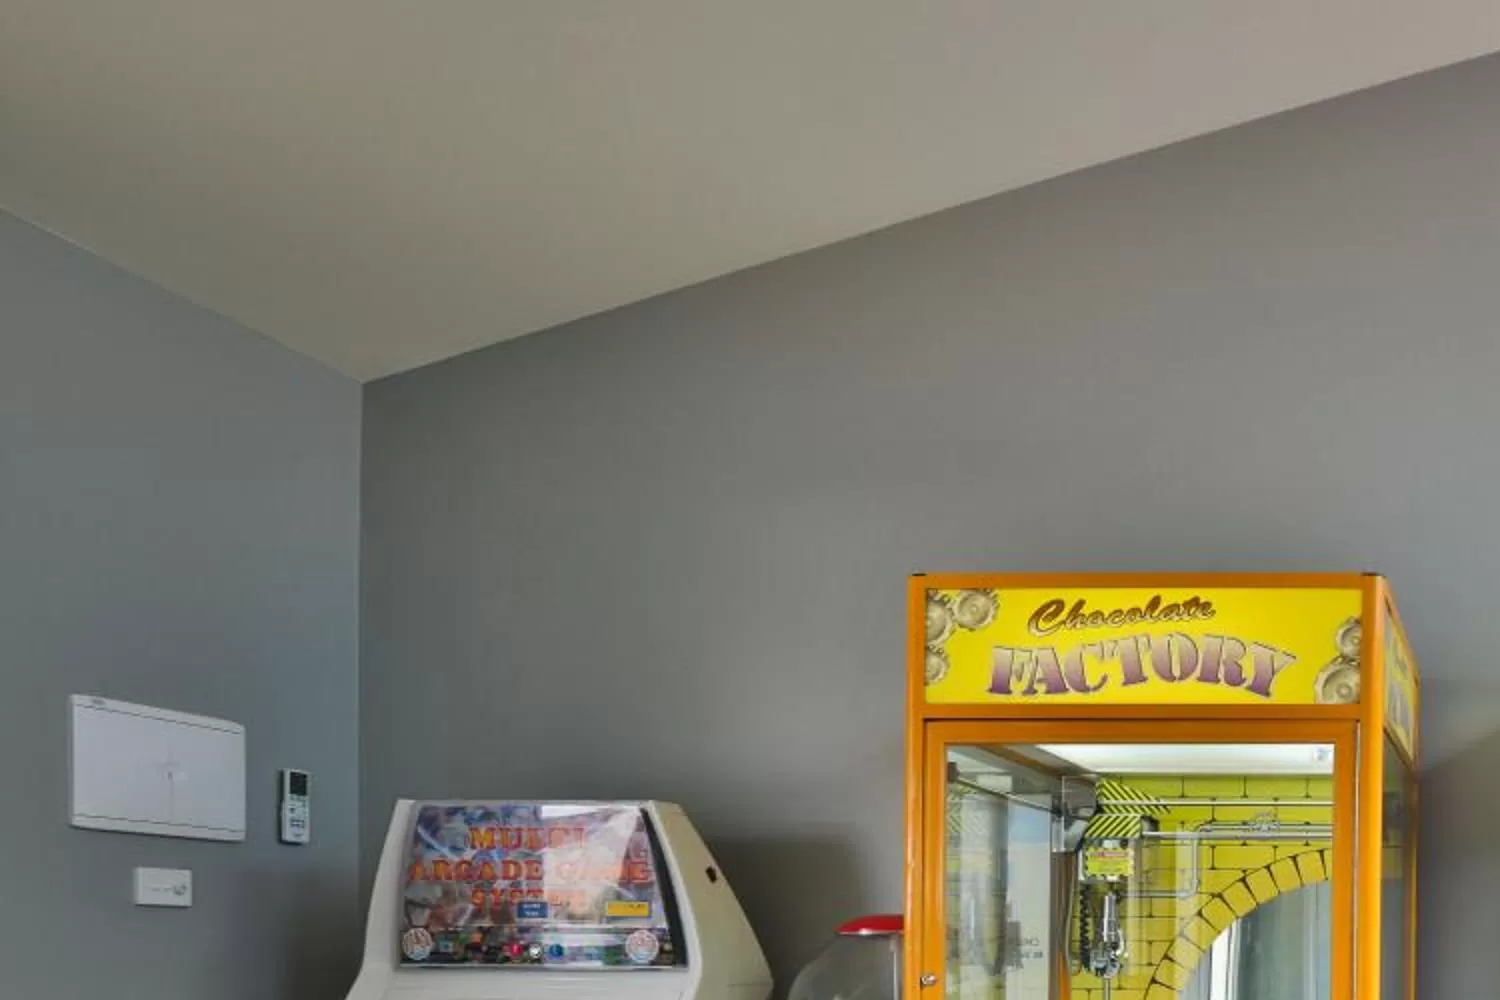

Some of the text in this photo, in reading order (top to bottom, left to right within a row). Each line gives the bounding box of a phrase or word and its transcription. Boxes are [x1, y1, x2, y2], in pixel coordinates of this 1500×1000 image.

[1028, 594, 1217, 637] Chocolate
[987, 632, 1297, 698] FACTORY
[469, 826, 586, 850] MULTI
[408, 859, 544, 882] ARCADE
